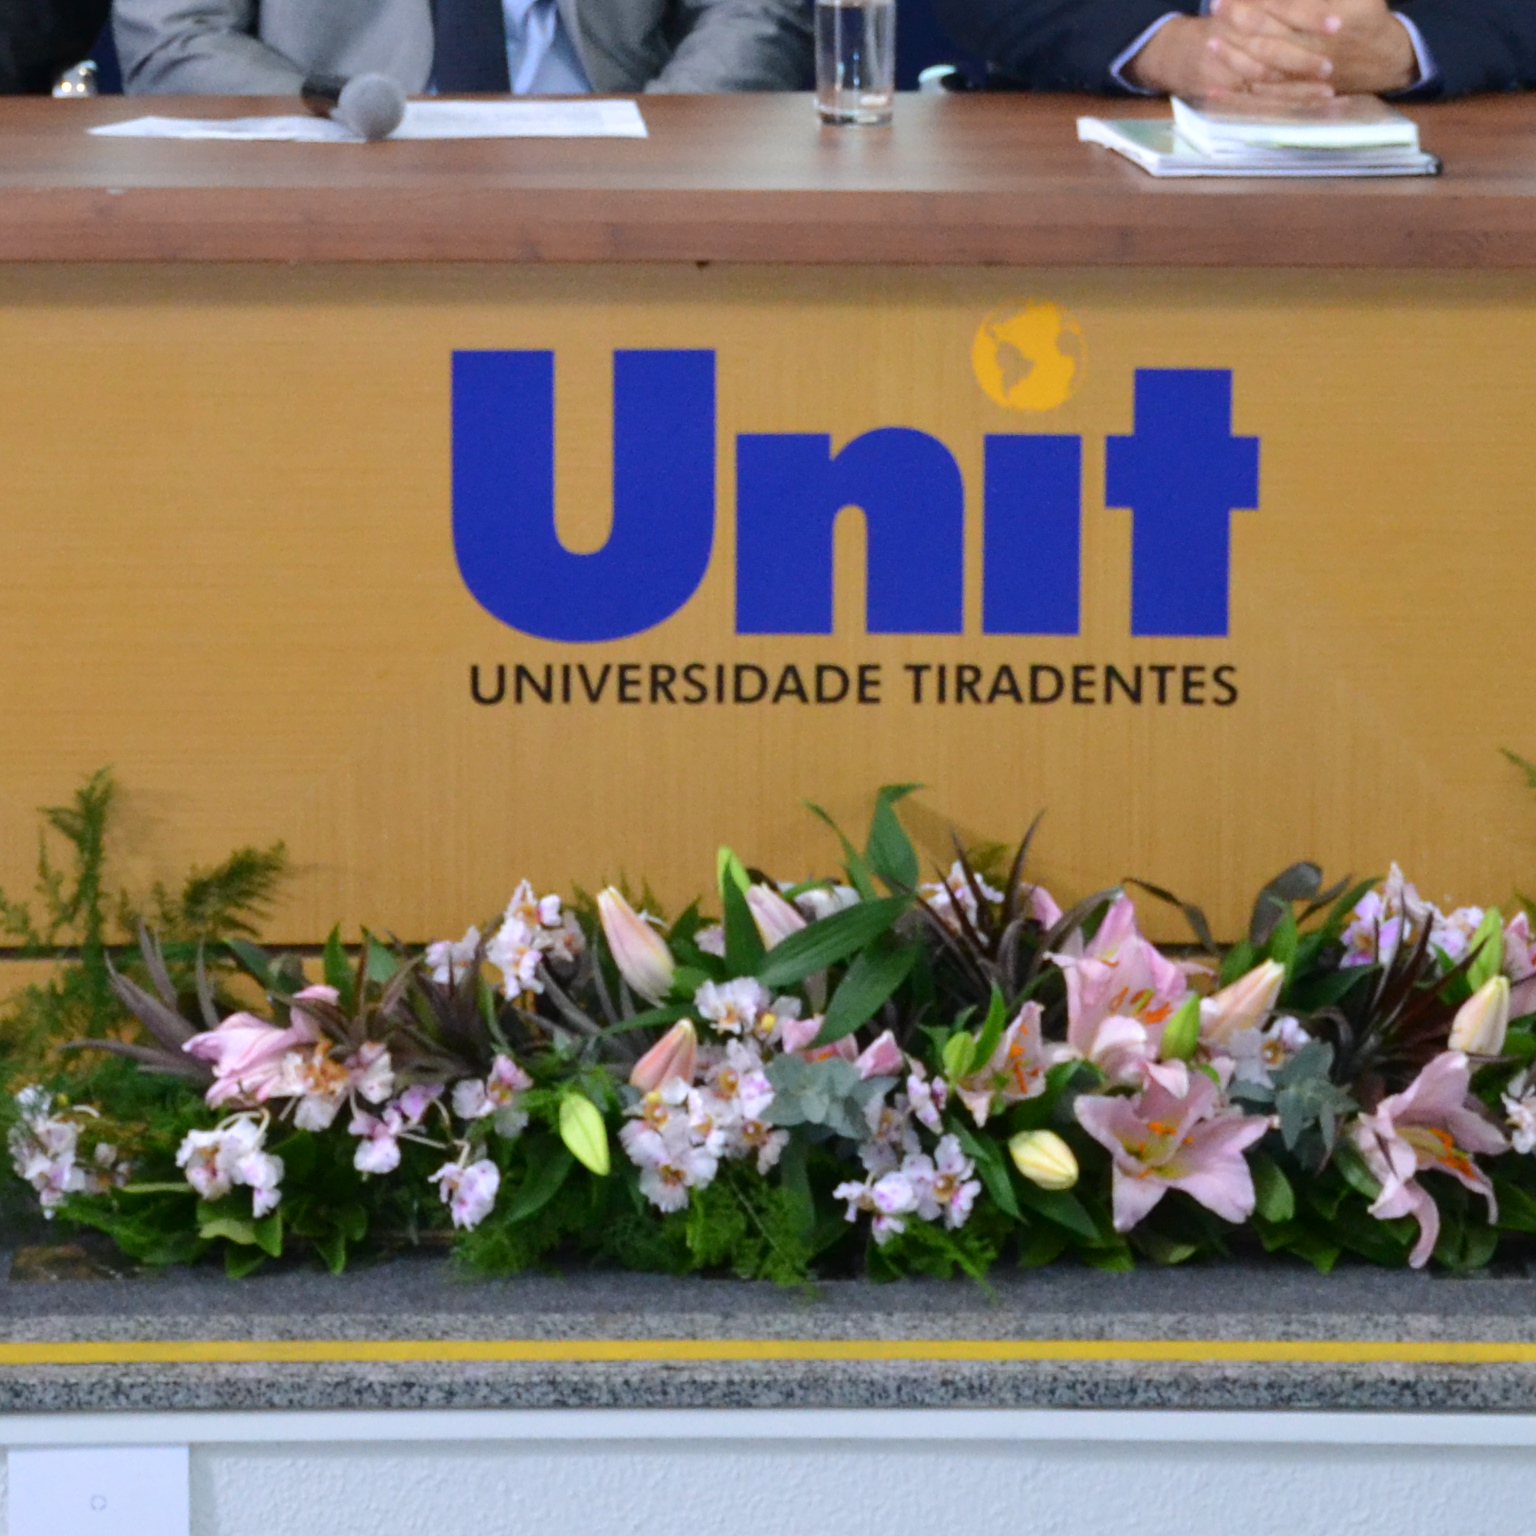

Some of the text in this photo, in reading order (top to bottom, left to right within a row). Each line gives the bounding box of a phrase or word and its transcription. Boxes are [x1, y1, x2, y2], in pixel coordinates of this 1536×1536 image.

[451, 298, 1259, 643] Unit
[469, 663, 1239, 707] UNIVERSIDADE TIRADENTES
